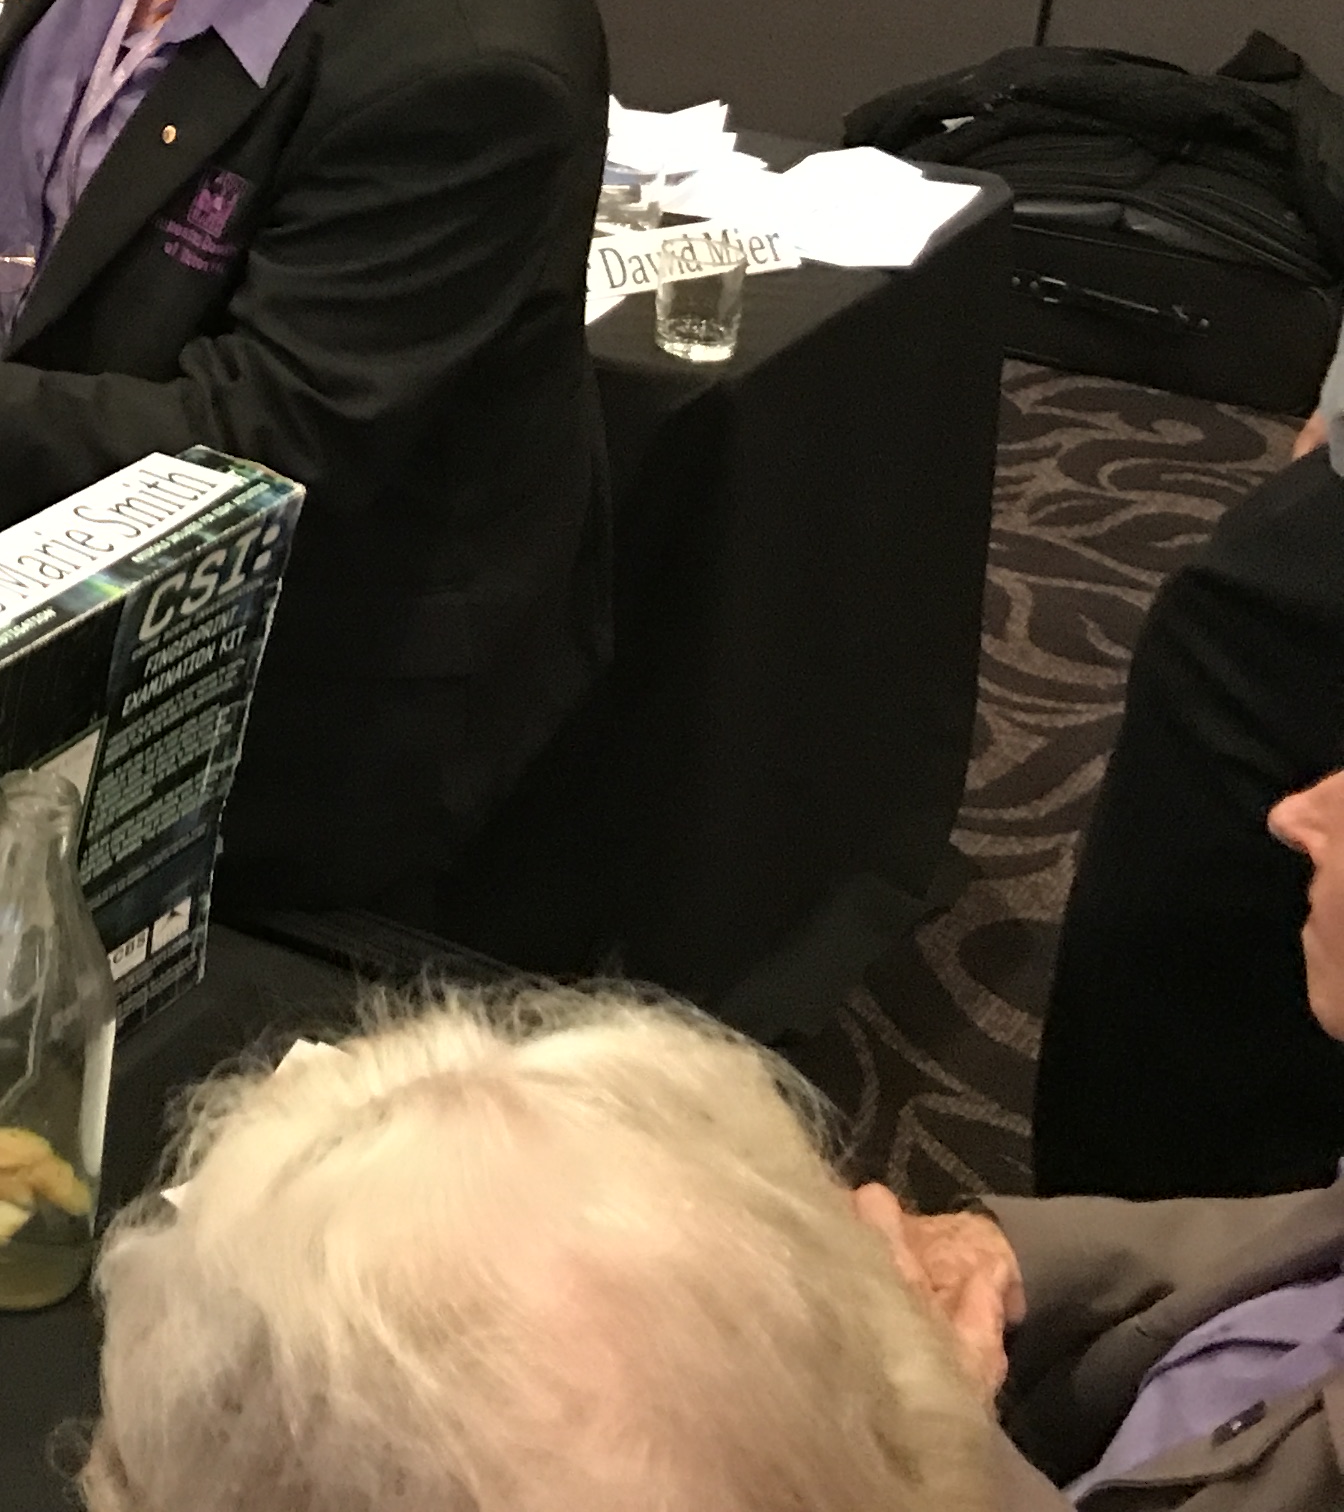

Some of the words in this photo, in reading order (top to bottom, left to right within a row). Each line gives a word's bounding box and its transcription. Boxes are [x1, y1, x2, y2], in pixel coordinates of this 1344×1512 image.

[598, 233, 703, 289] David
[73, 469, 218, 539] Smith
[139, 524, 281, 642] CSI:
[122, 640, 216, 718] EXAMINATION
[219, 625, 248, 656] KIT
[144, 604, 240, 678] FINGERPRINT
